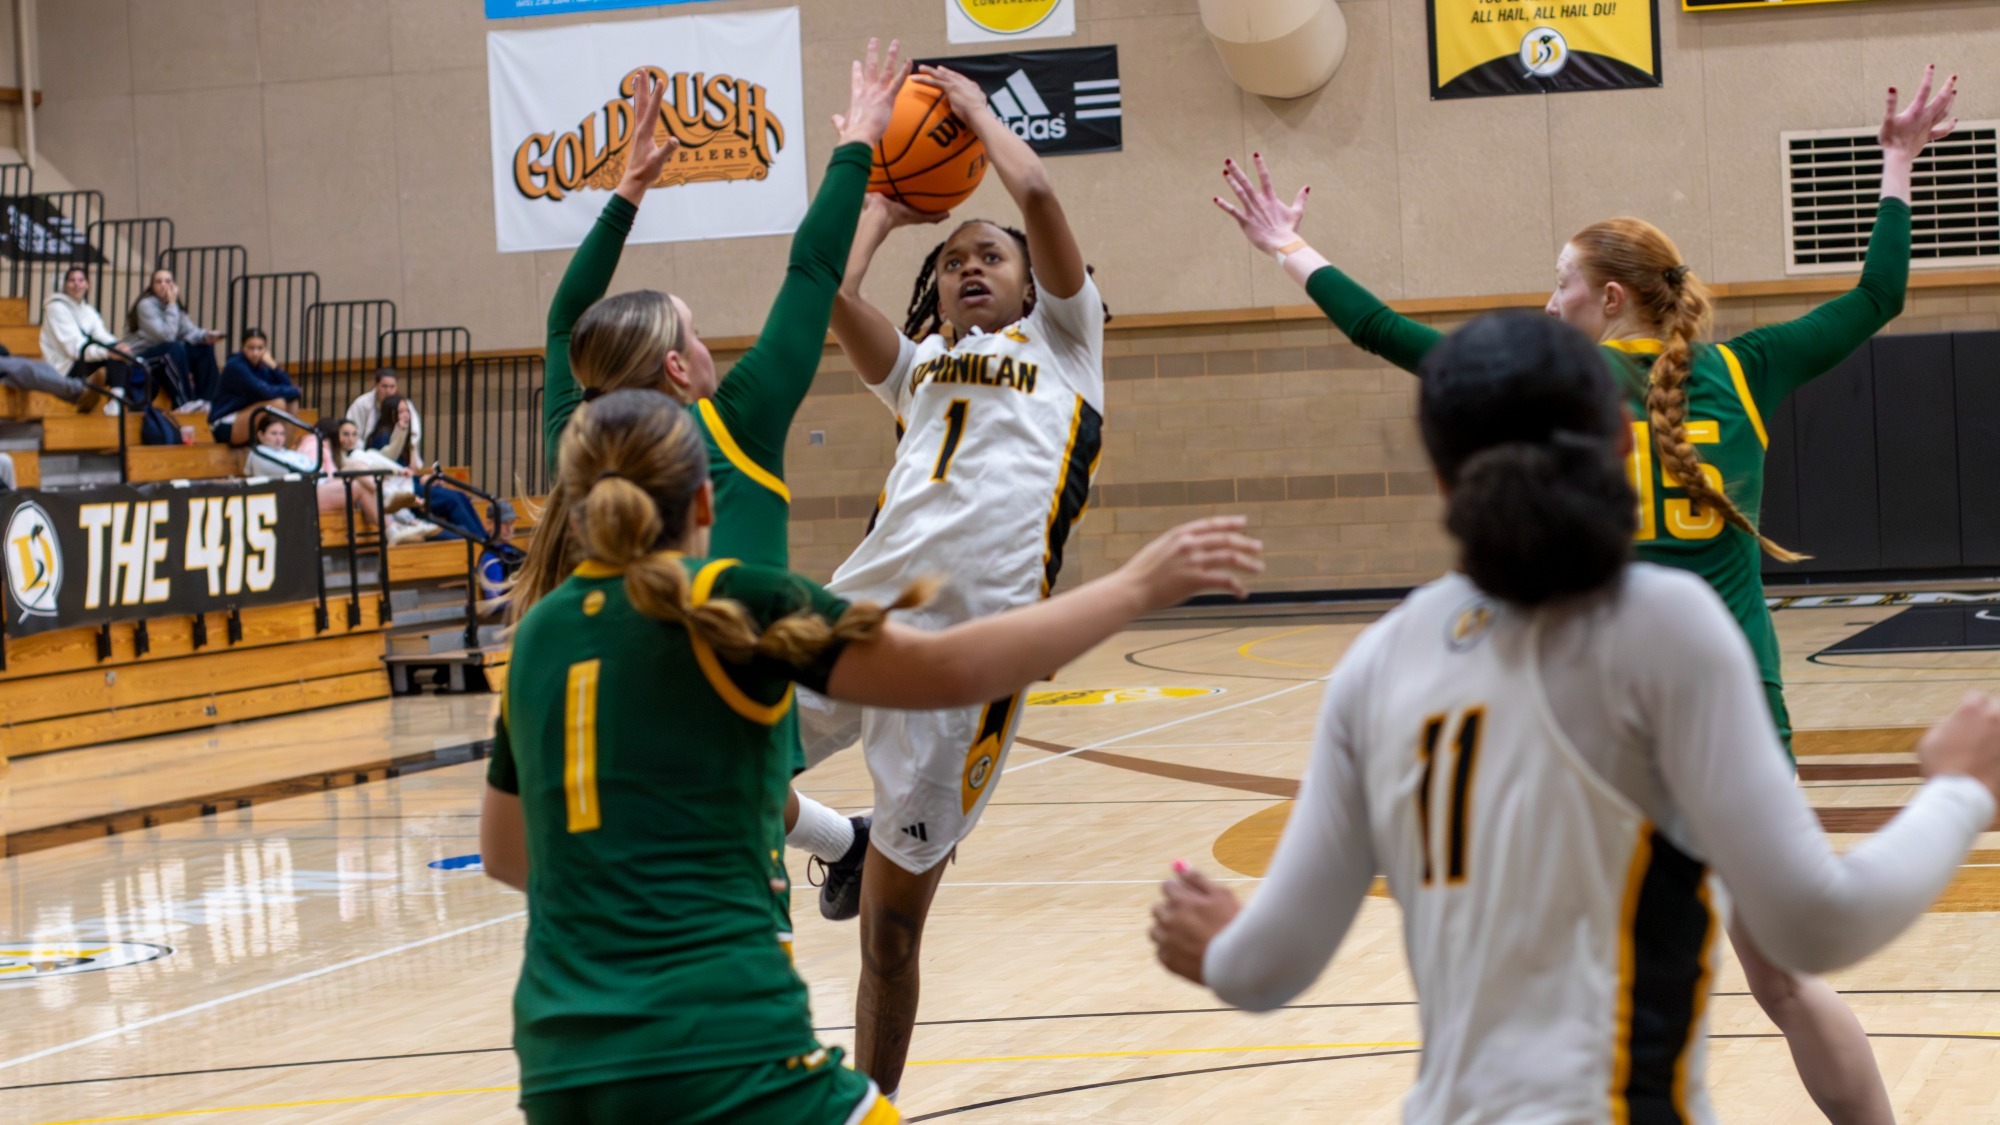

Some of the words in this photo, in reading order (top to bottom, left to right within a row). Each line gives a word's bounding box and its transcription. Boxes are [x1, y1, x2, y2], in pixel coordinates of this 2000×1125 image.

[1471, 11, 1493, 23] ALL
[1498, 8, 1529, 22] HAIL,
[1533, 7, 1556, 20] ALL
[1560, 4, 1588, 18] HAIL
[1593, 2, 1617, 16] DU!
[514, 99, 636, 201] GOLD
[618, 65, 785, 167] RUSH
[678, 147, 749, 163] ELERS
[930, 397, 970, 483] 1
[1626, 419, 1725, 541] 15
[78, 500, 171, 610] THE
[564, 658, 601, 834] 1
[1418, 703, 1486, 889] 11
